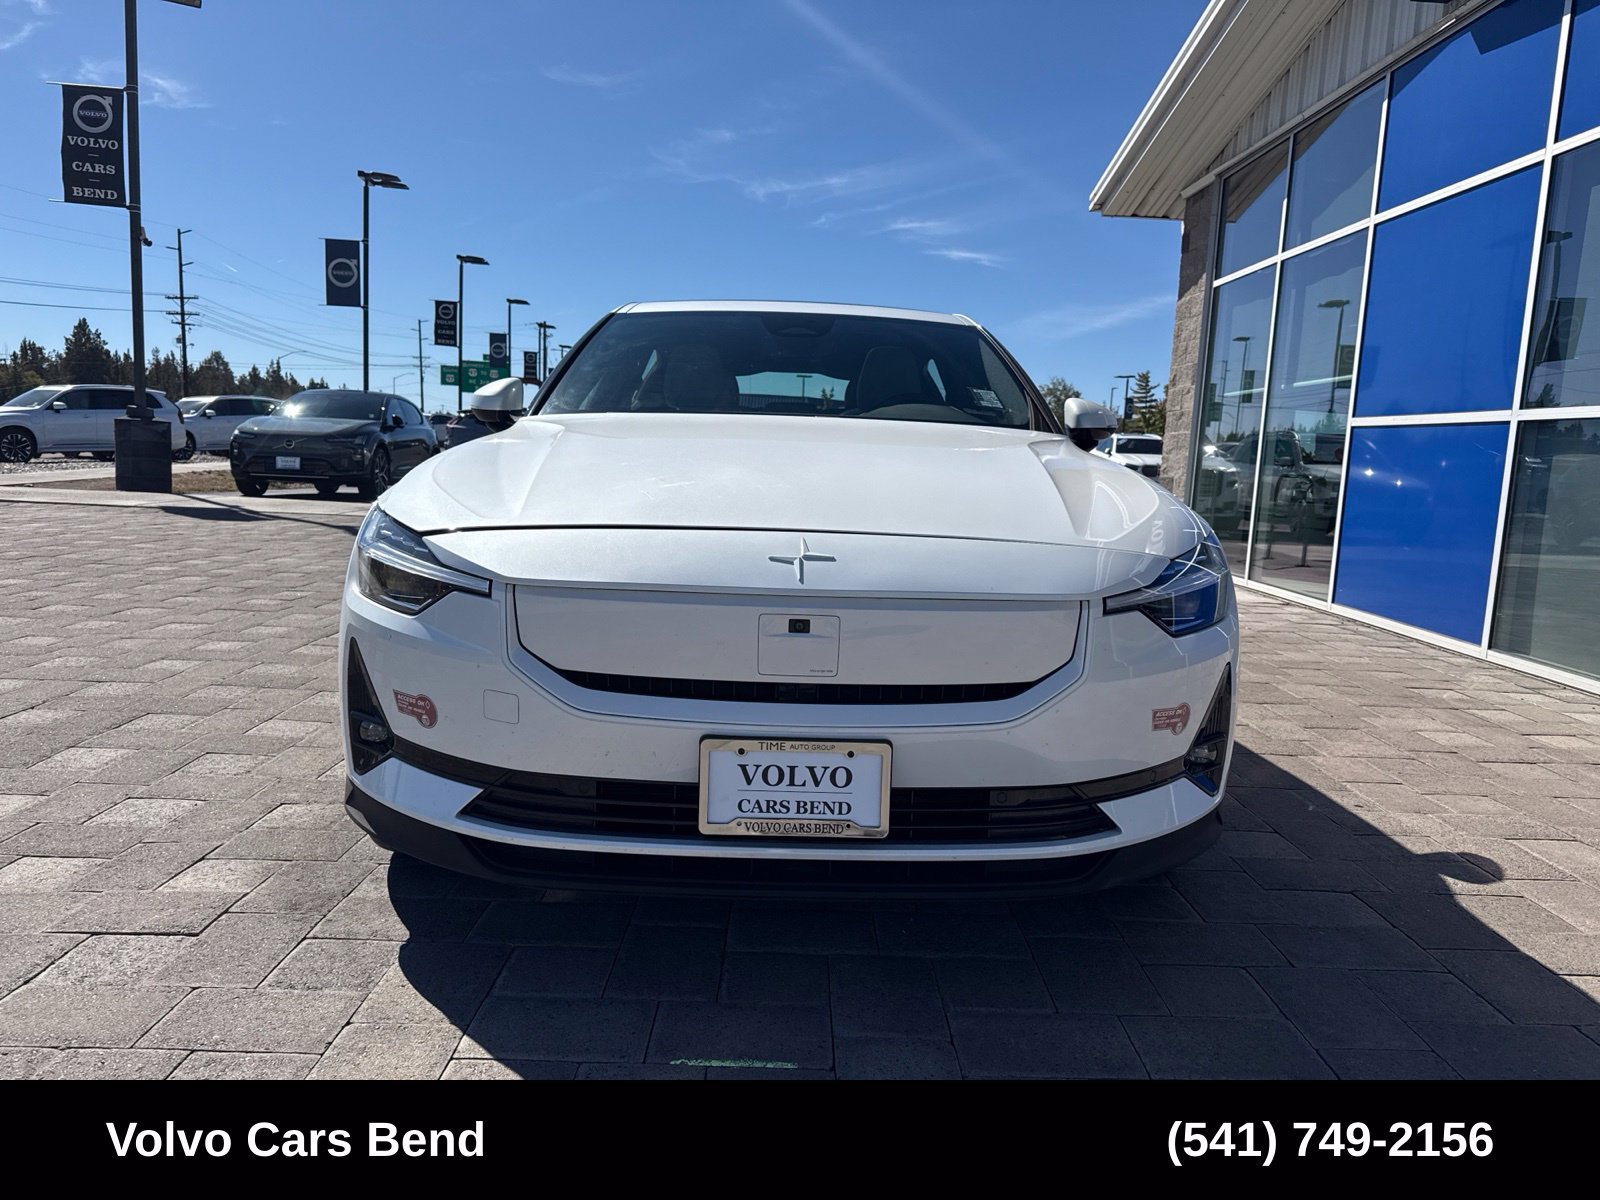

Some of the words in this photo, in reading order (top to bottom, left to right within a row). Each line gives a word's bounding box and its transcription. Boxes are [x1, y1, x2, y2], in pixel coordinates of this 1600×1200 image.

[78, 110, 108, 118] VOLVO
[67, 135, 119, 150] VOLVO
[72, 161, 116, 175] CARS
[72, 186, 117, 200] BEND
[398, 694, 416, 703] ACCESS
[758, 741, 786, 751] TIME
[790, 743, 810, 751] AUTO
[737, 764, 853, 789] VOLVO
[737, 798, 790, 815] CARS
[795, 800, 852, 816] BEND
[744, 821, 781, 832] VOLVO
[783, 822, 812, 833] CARS
[815, 823, 845, 834] BEND
